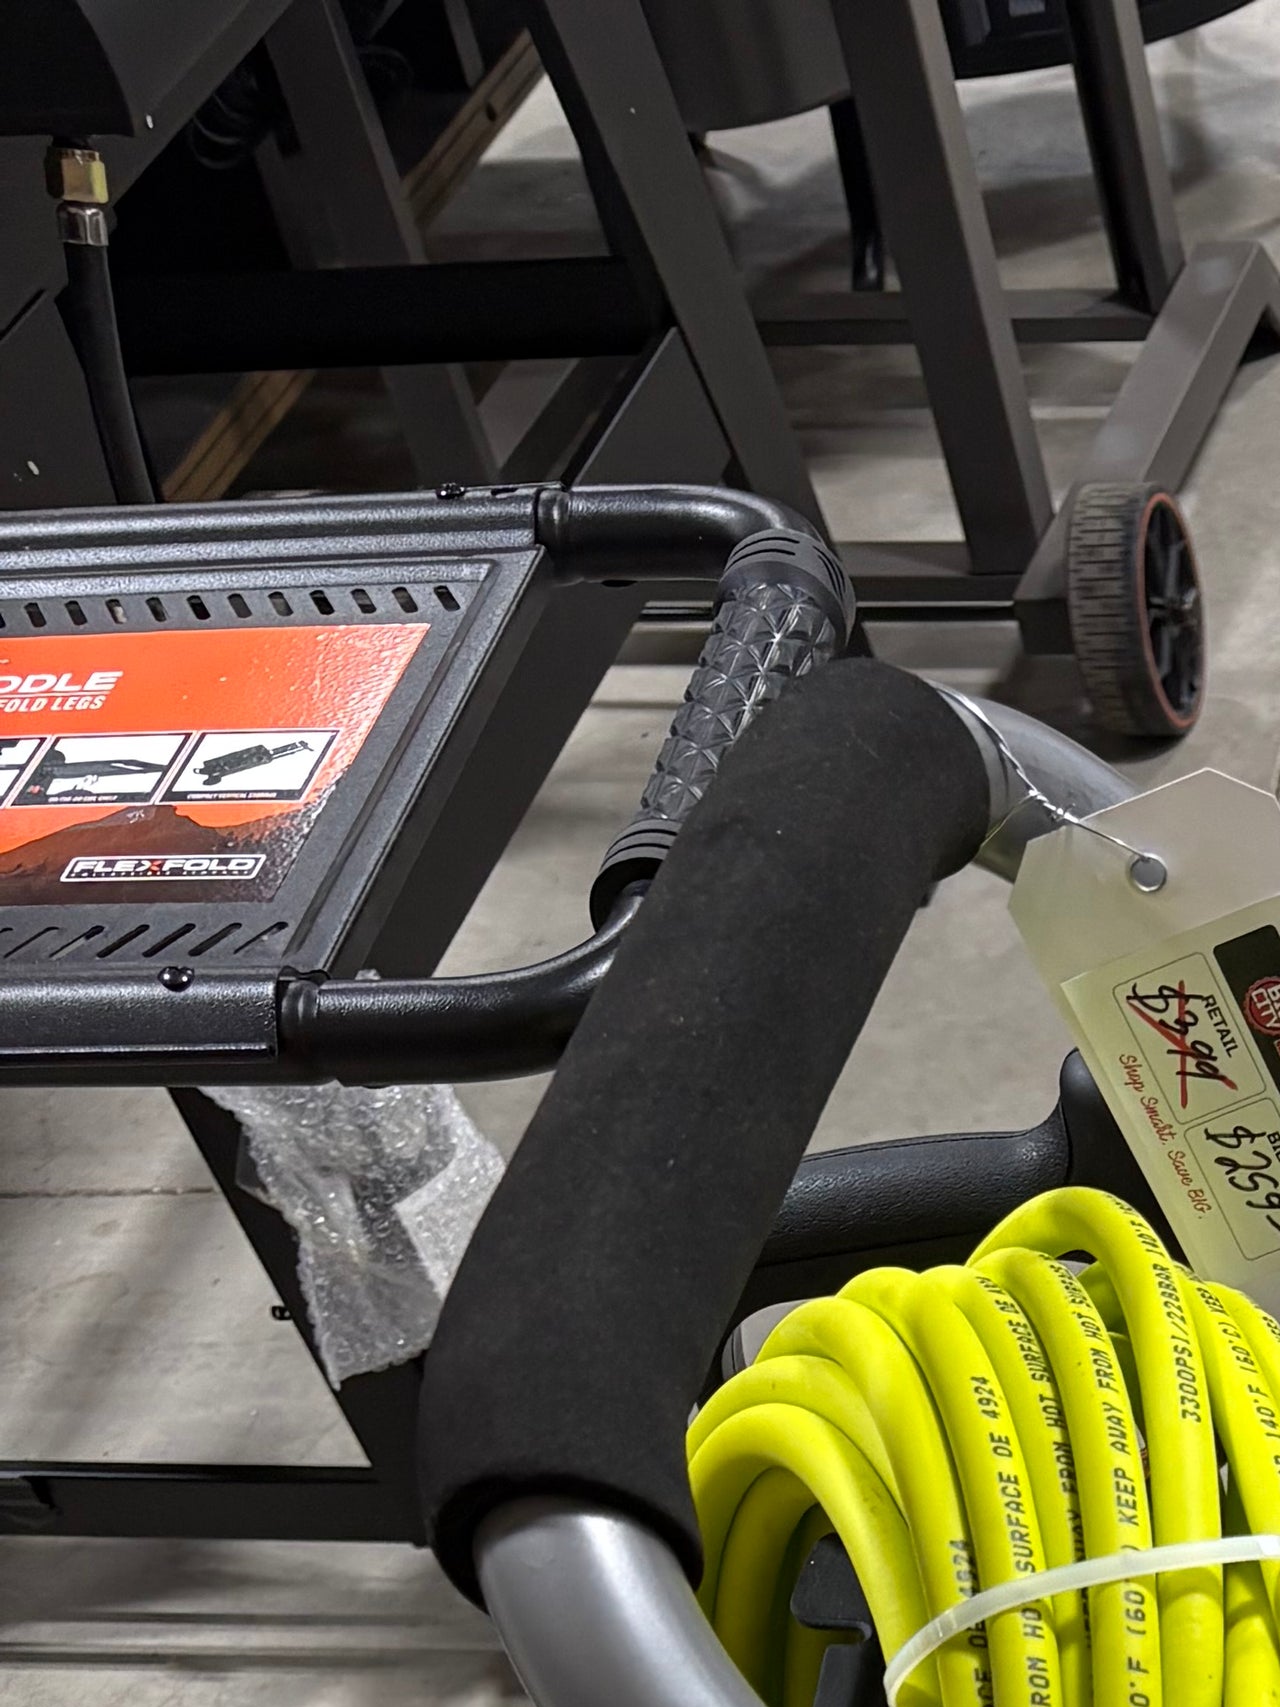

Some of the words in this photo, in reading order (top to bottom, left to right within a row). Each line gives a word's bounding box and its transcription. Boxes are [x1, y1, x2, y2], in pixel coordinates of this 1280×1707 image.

[50, 695, 107, 712] LEGS
[73, 858, 256, 873] FLEXFOLD
[1202, 994, 1240, 1058] RETAIL
[1118, 1053, 1146, 1093] Shop
[1167, 1149, 1194, 1187] Save
[1008, 1319, 1052, 1384] SURFACE
[1076, 1311, 1106, 1342] HOT
[1152, 1262, 1203, 1424] 3300PSI/228BAR
[969, 1375, 1000, 1420] 4924
[1038, 1393, 1066, 1430] HOT
[1102, 1401, 1132, 1456] AWAY
[997, 1471, 1037, 1575] SURFACE
[1113, 1467, 1140, 1527] KEEP
[1021, 1605, 1046, 1639] HO
